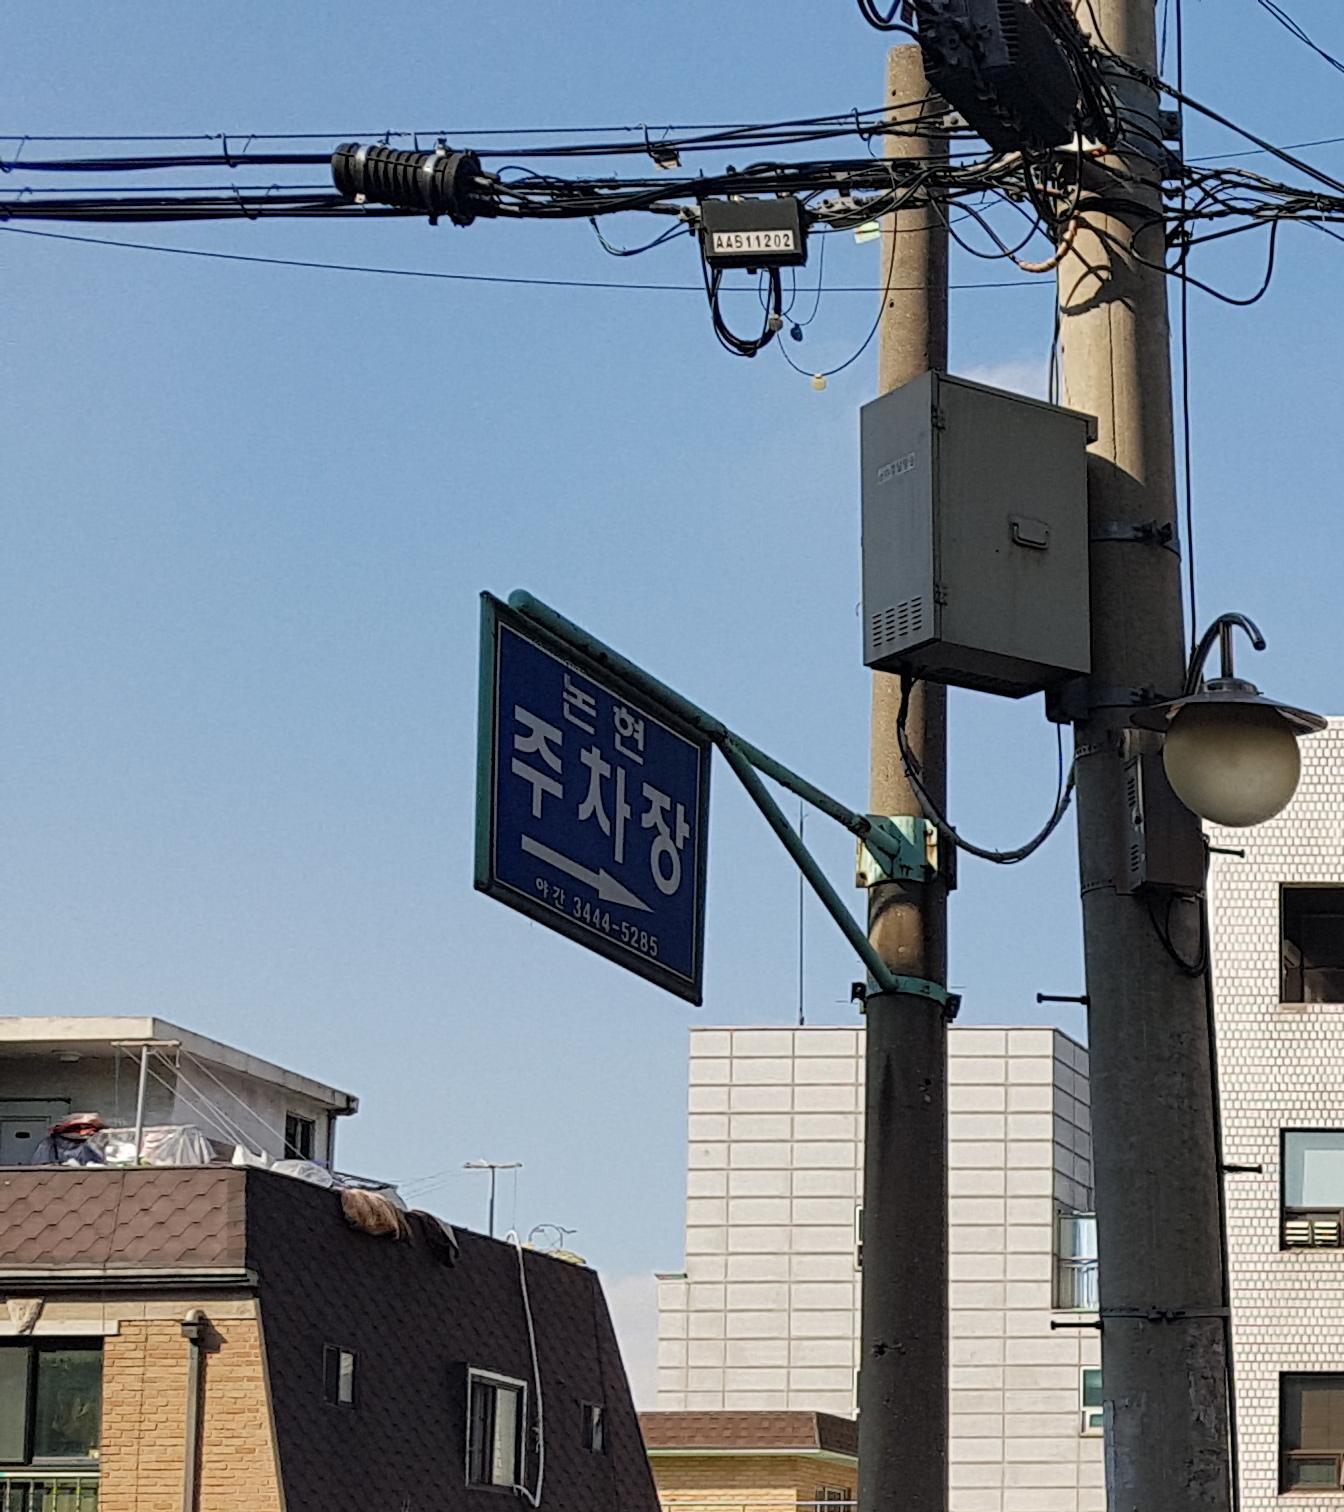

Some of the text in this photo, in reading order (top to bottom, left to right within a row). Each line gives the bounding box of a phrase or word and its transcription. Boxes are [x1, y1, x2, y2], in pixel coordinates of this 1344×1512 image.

[562, 672, 646, 766] 논현
[511, 704, 690, 896] 주차장
[534, 877, 659, 957] 야간 3444-5285
